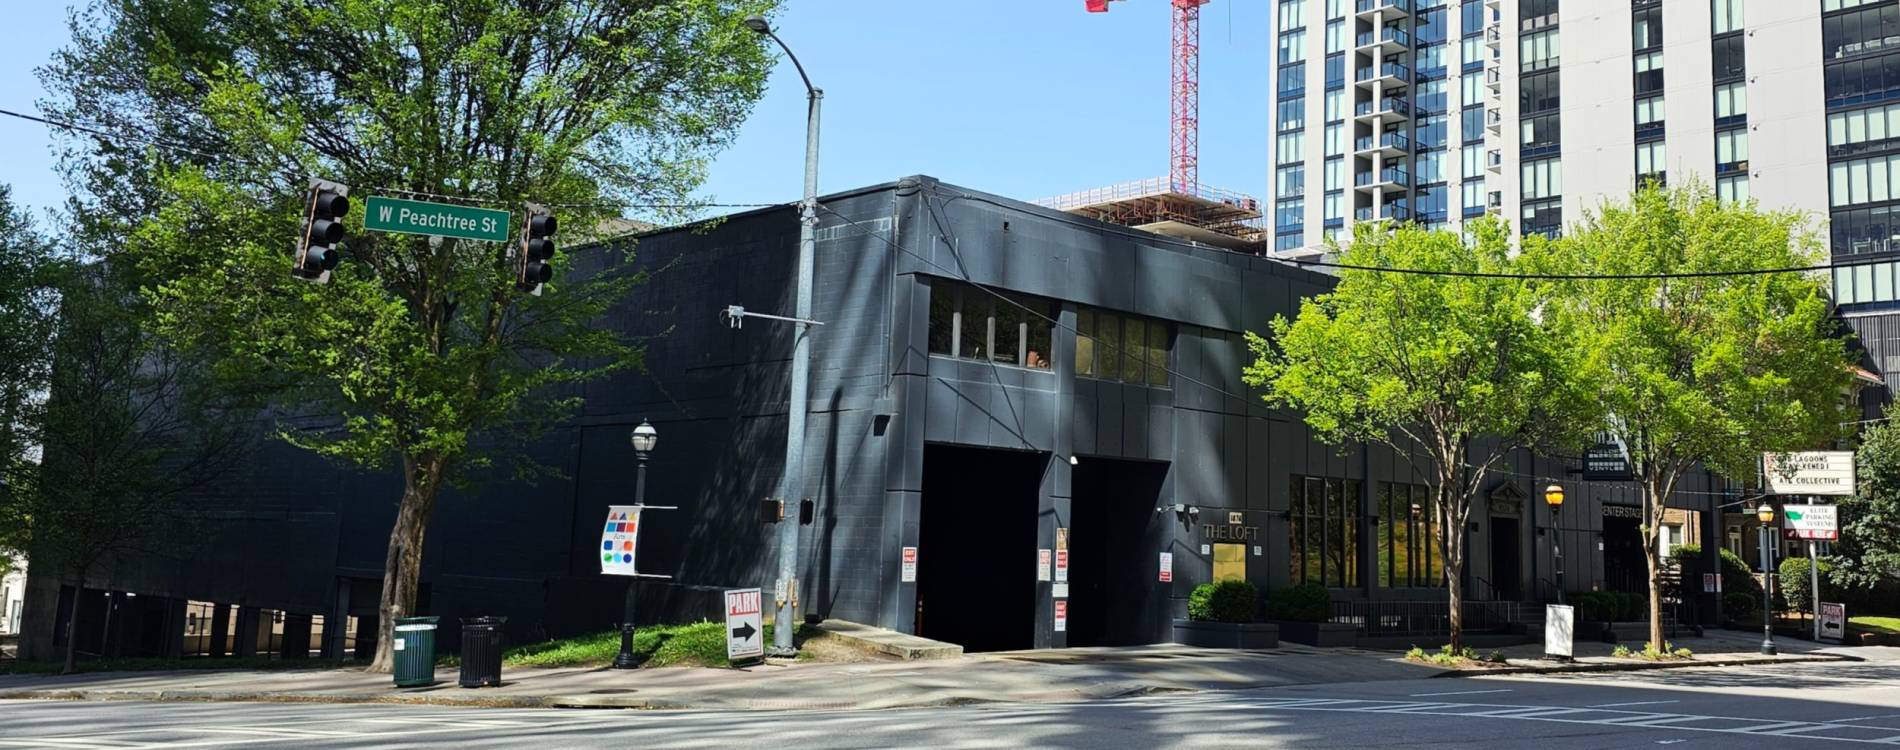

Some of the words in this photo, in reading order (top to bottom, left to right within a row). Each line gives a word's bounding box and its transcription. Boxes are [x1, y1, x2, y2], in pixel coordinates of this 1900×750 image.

[379, 206, 392, 223] W
[400, 208, 477, 231] Peachtree
[481, 216, 497, 233] St
[1796, 477, 1840, 485] COLLECTIVE
[1203, 524, 1227, 539] THE
[1229, 525, 1260, 541] LOFT
[728, 592, 759, 614] PARK
[1823, 605, 1840, 616] PARK
